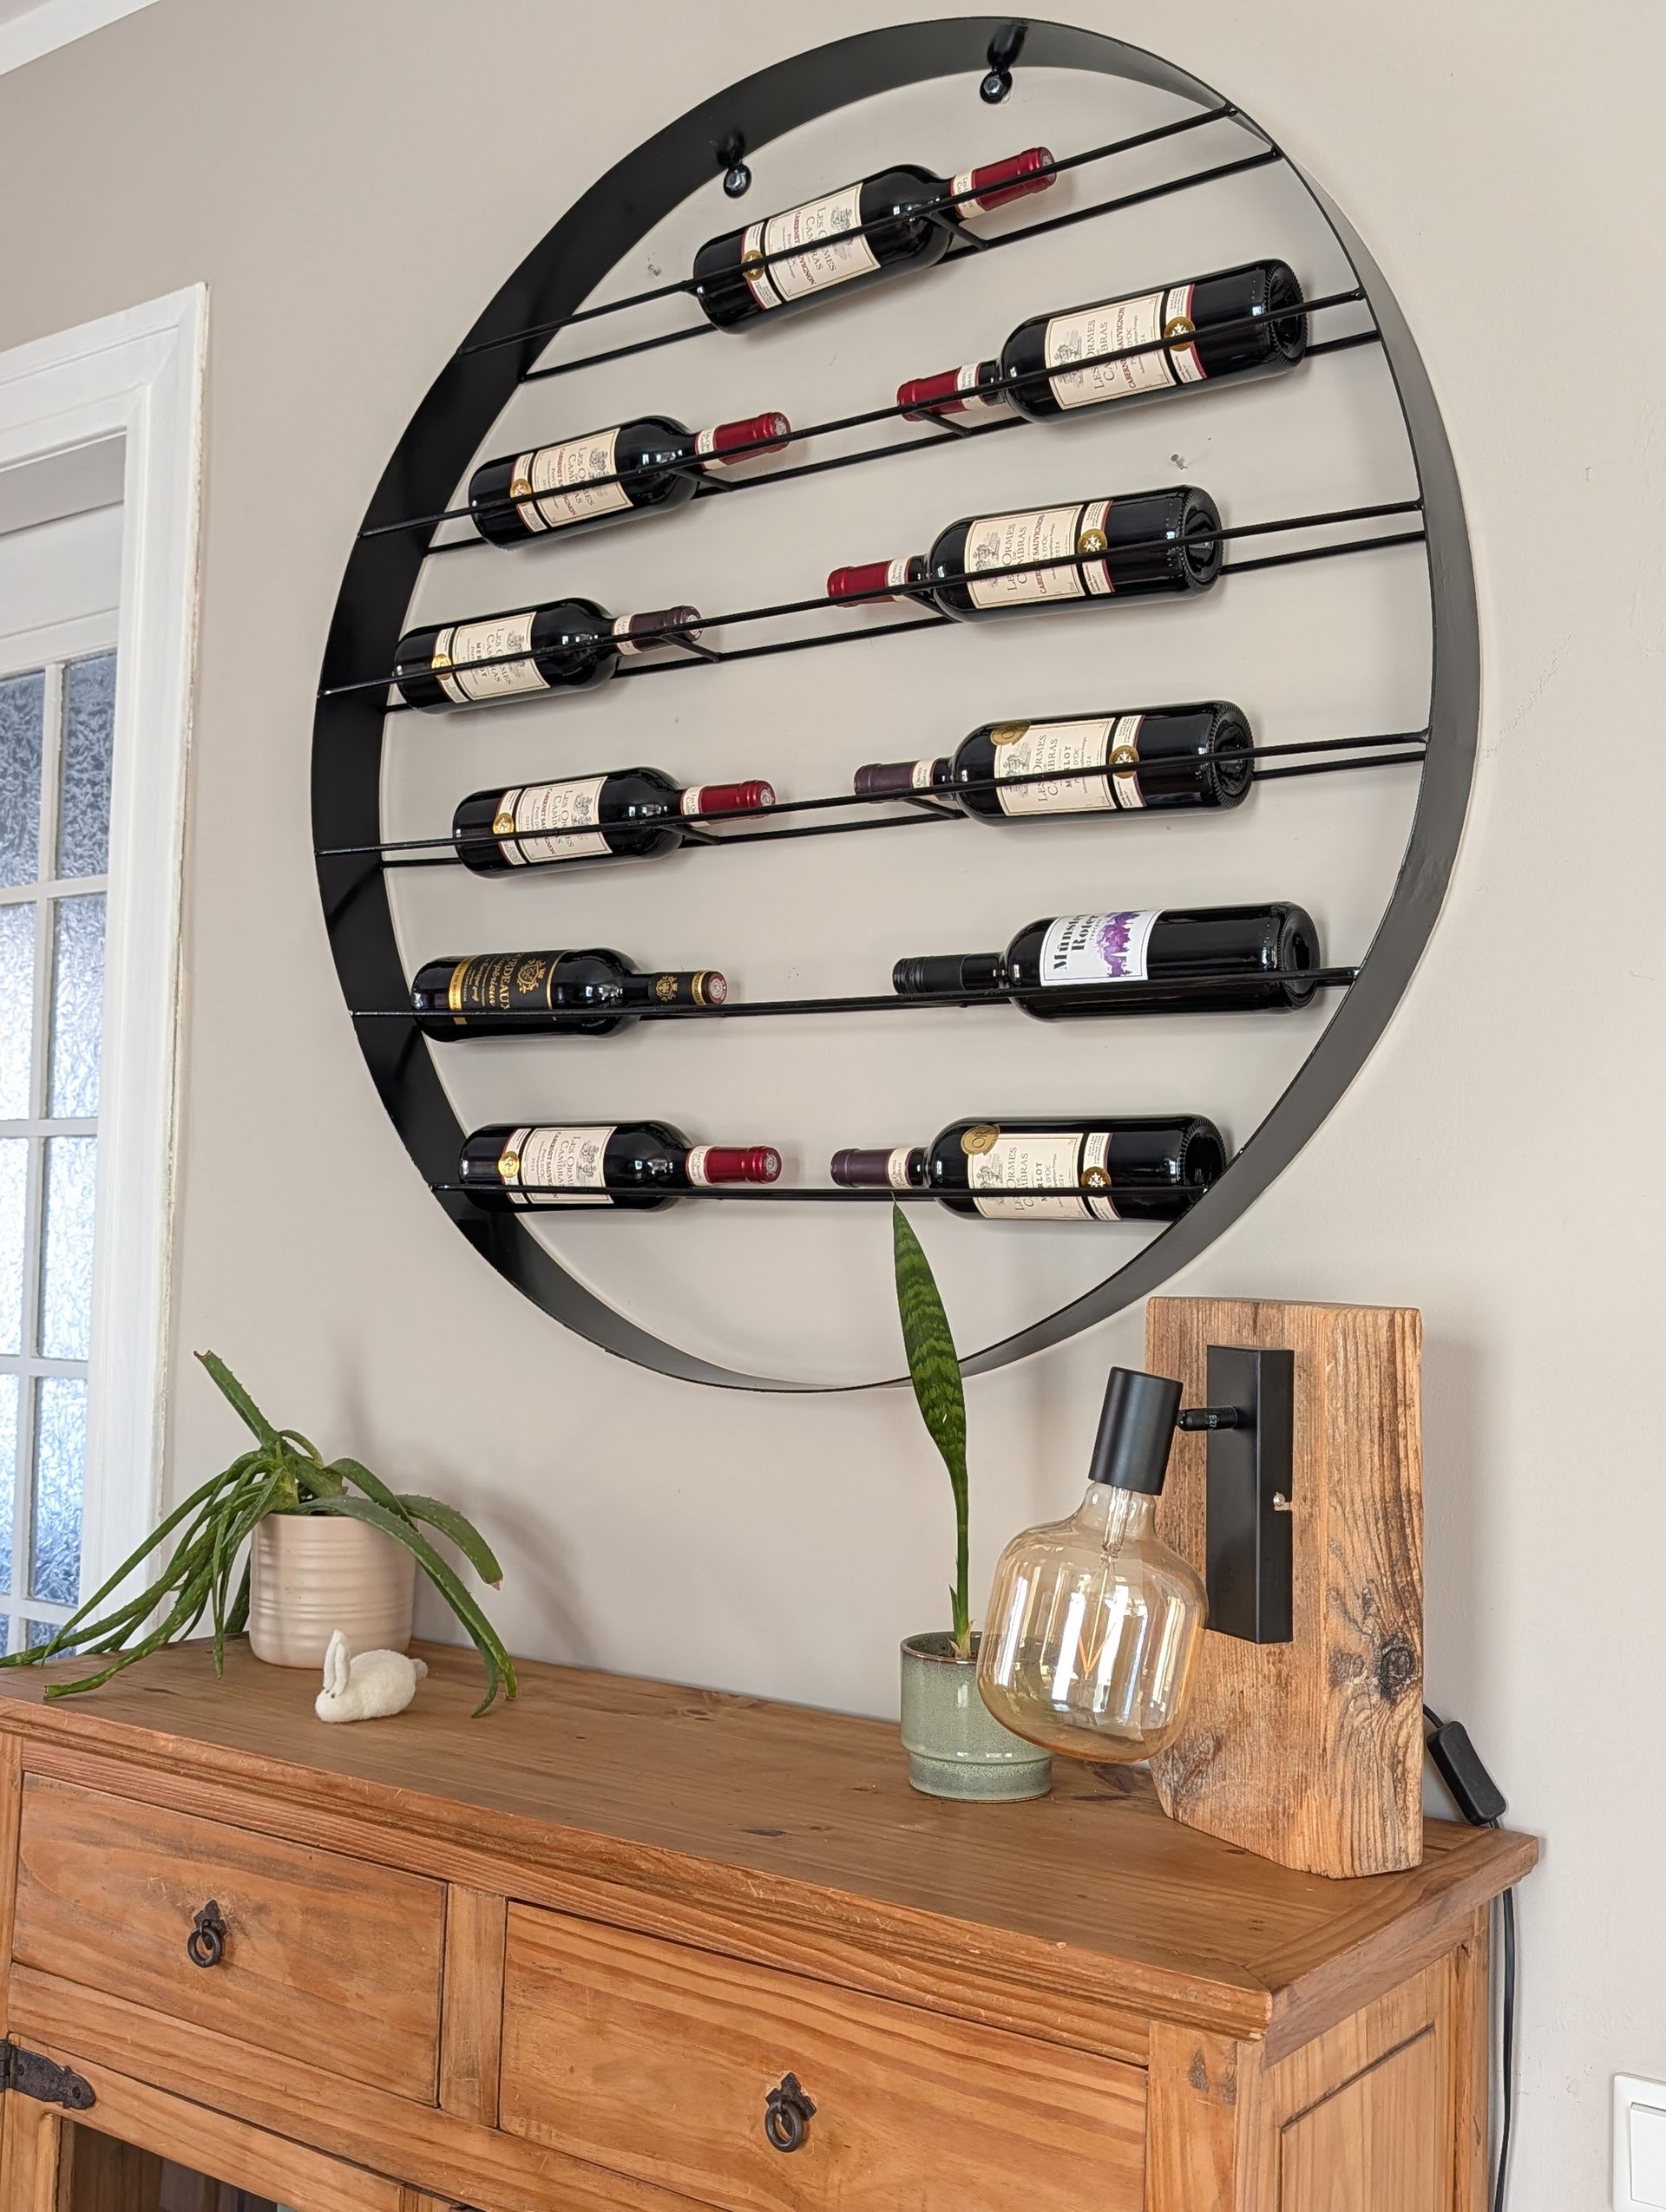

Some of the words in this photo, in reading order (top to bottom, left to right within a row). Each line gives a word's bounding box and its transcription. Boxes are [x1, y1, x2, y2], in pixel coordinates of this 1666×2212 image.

[1100, 322, 1116, 382] CABRAS
[1092, 366, 1105, 389] LES
[1001, 523, 1016, 566] ORMES
[1033, 514, 1045, 556] SAUVIGNON
[1063, 745, 1073, 789] MRLOT
[569, 1135, 581, 1154] LES
[971, 1127, 991, 1149] OR
[1006, 1147, 1018, 1189] ORMES
